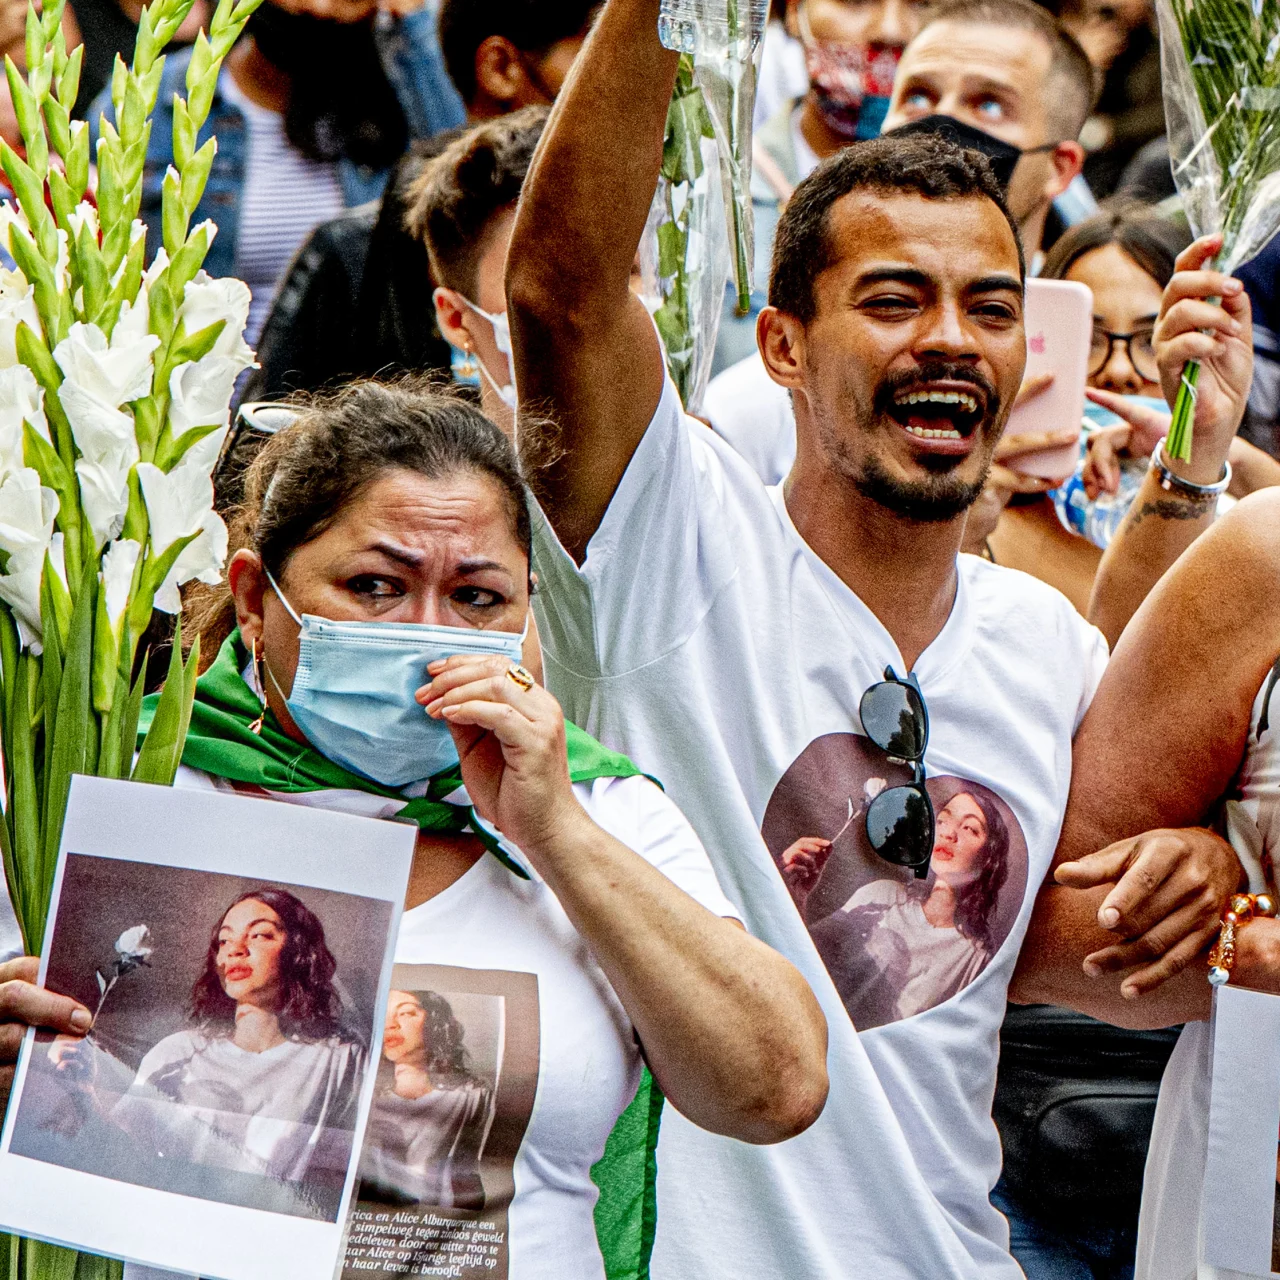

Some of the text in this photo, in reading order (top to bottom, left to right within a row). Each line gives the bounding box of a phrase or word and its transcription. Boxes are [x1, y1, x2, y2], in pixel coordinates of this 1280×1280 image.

[351, 1209, 496, 1230] rica en Alice Alburquerque een
[348, 1232, 499, 1256] edeleven door een witte roos te
[355, 1221, 414, 1238] simpelweg
[415, 1227, 440, 1241] tegen
[440, 1229, 470, 1241] zinloos
[471, 1231, 504, 1244] geweld
[352, 1257, 382, 1270] haar
[382, 1260, 410, 1273] leven
[410, 1264, 420, 1274] is
[420, 1263, 463, 1278] beroofd.
[366, 1246, 396, 1259] Alice
[397, 1250, 412, 1262] op
[413, 1250, 447, 1266] 15jarige
[448, 1252, 483, 1268] leeftijd
[484, 1257, 498, 1270] op
